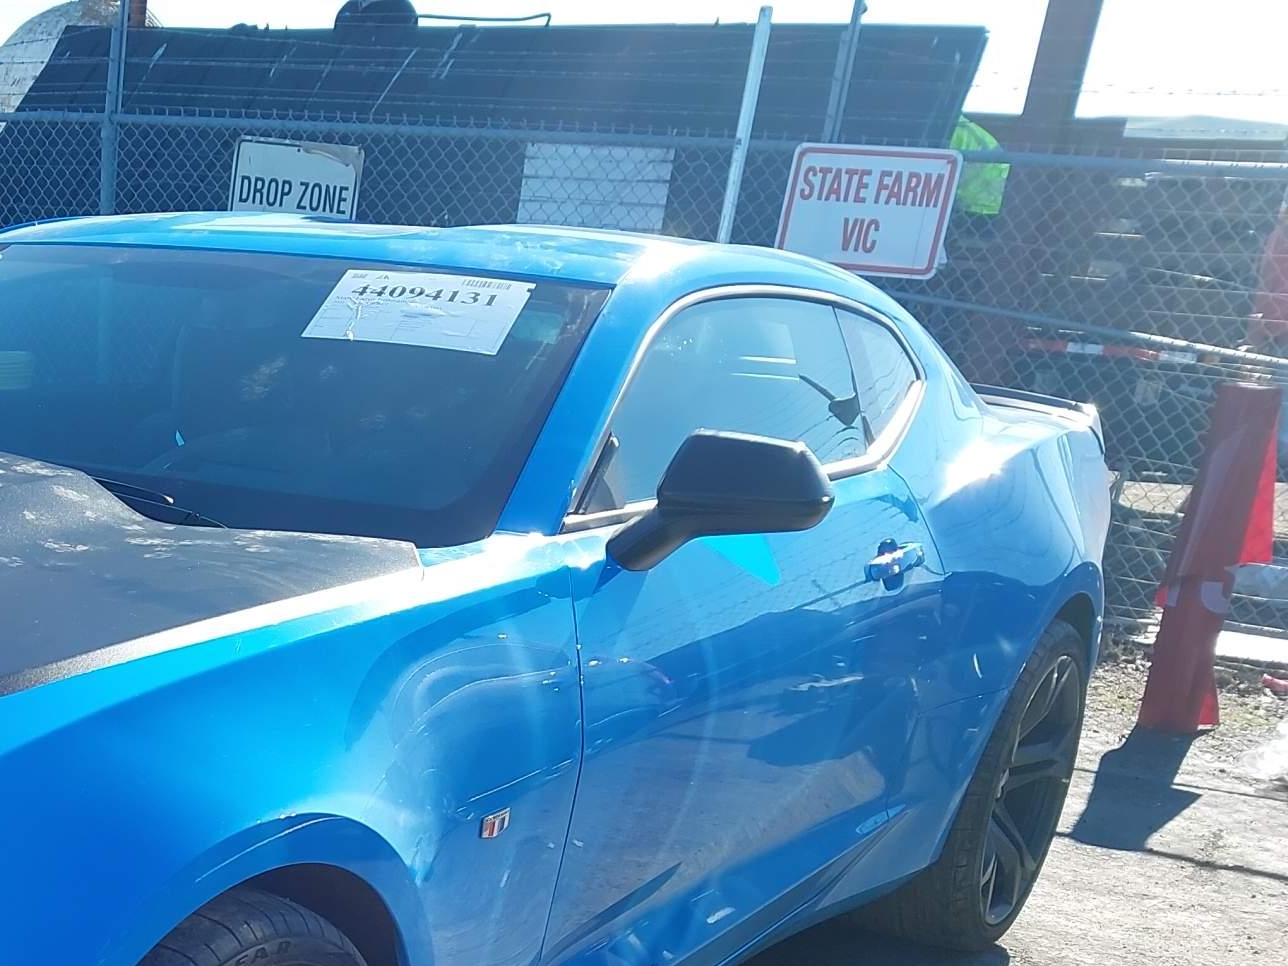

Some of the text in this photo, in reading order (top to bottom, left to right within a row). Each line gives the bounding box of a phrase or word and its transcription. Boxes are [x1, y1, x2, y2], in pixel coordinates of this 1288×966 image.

[238, 175, 350, 214] DROP ZONE
[799, 165, 945, 208] STATE FARM
[841, 216, 880, 253] VIC
[351, 282, 498, 306] 44094131
